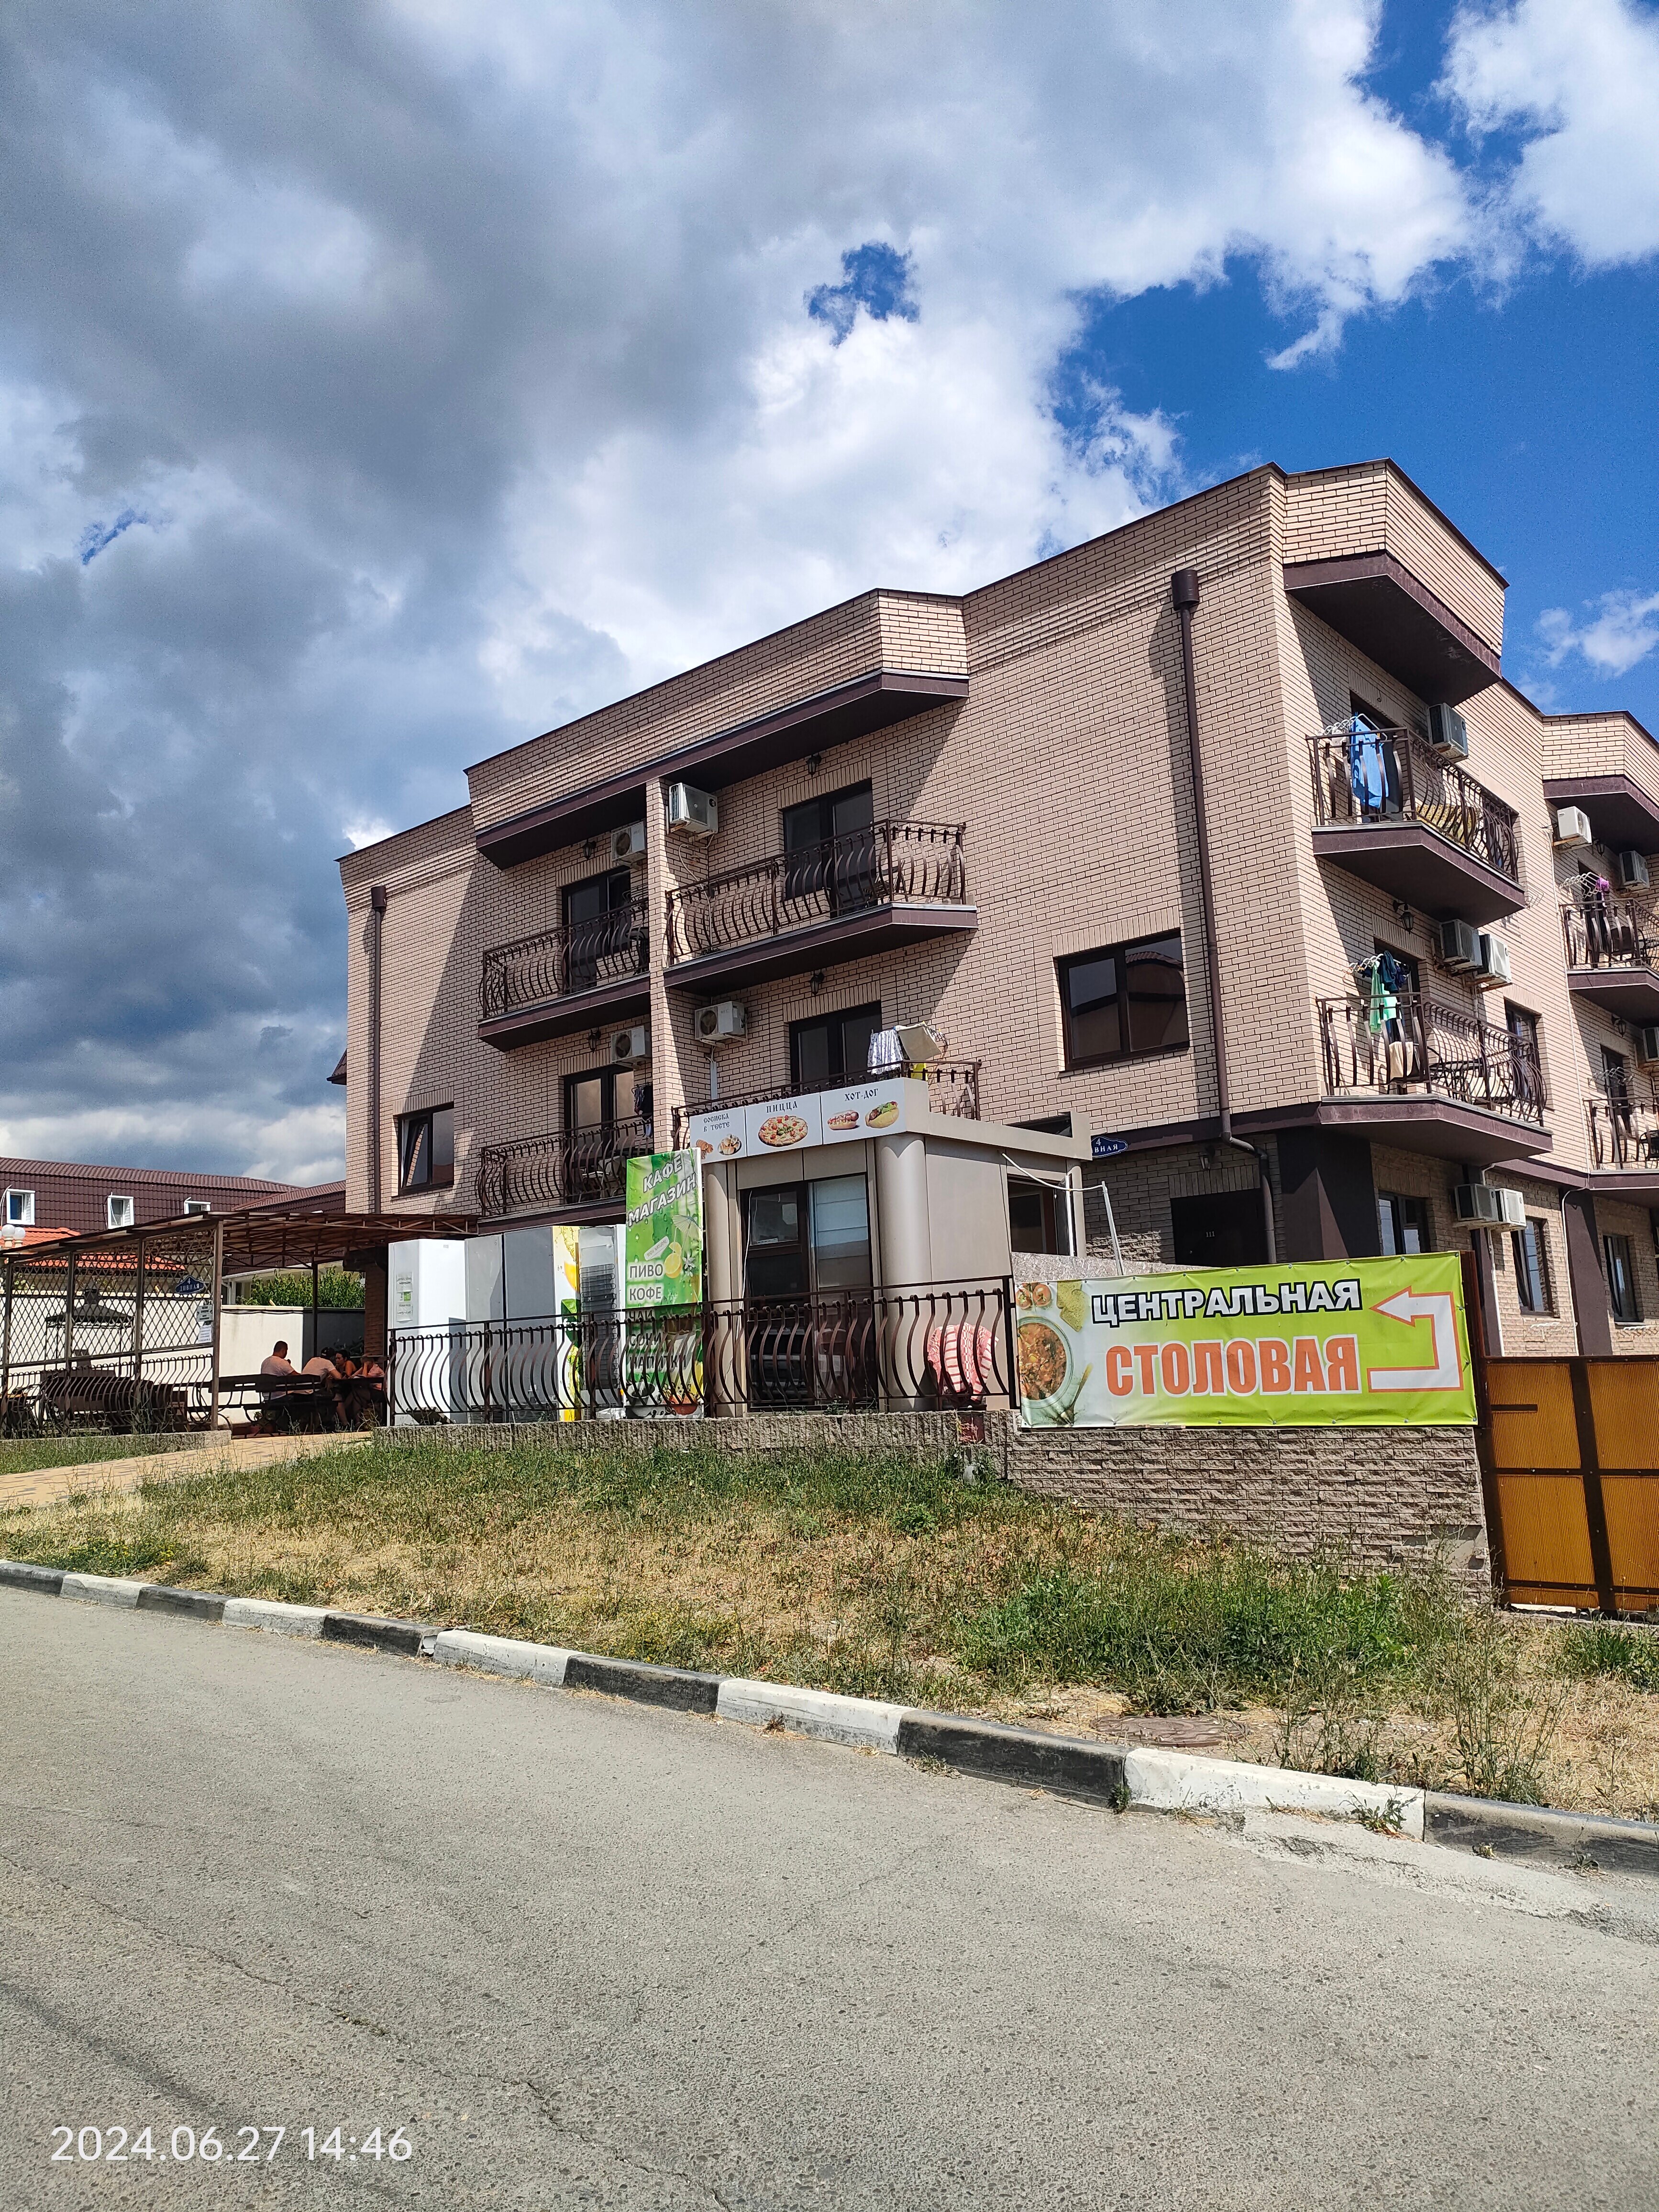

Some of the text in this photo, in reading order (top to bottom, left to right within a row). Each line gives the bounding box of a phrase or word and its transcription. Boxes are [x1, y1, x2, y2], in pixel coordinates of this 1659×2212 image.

[844, 1088, 878, 1102] ХОТ-ДОГ
[766, 1101, 798, 1113] ПИЦЦА
[703, 1113, 729, 1124] СОСИСКА
[711, 1121, 730, 1131] ТЕСТЕ
[643, 1154, 683, 1193] КАФЕ
[628, 1172, 697, 1227] МАГАЗИН
[630, 1263, 664, 1278] ПИВО
[630, 1286, 662, 1301] КОФЕ
[1091, 1278, 1363, 1328] ЦЕНТРАЛЬНАЯ
[1106, 1334, 1361, 1397] СТОЛОВАЯ
